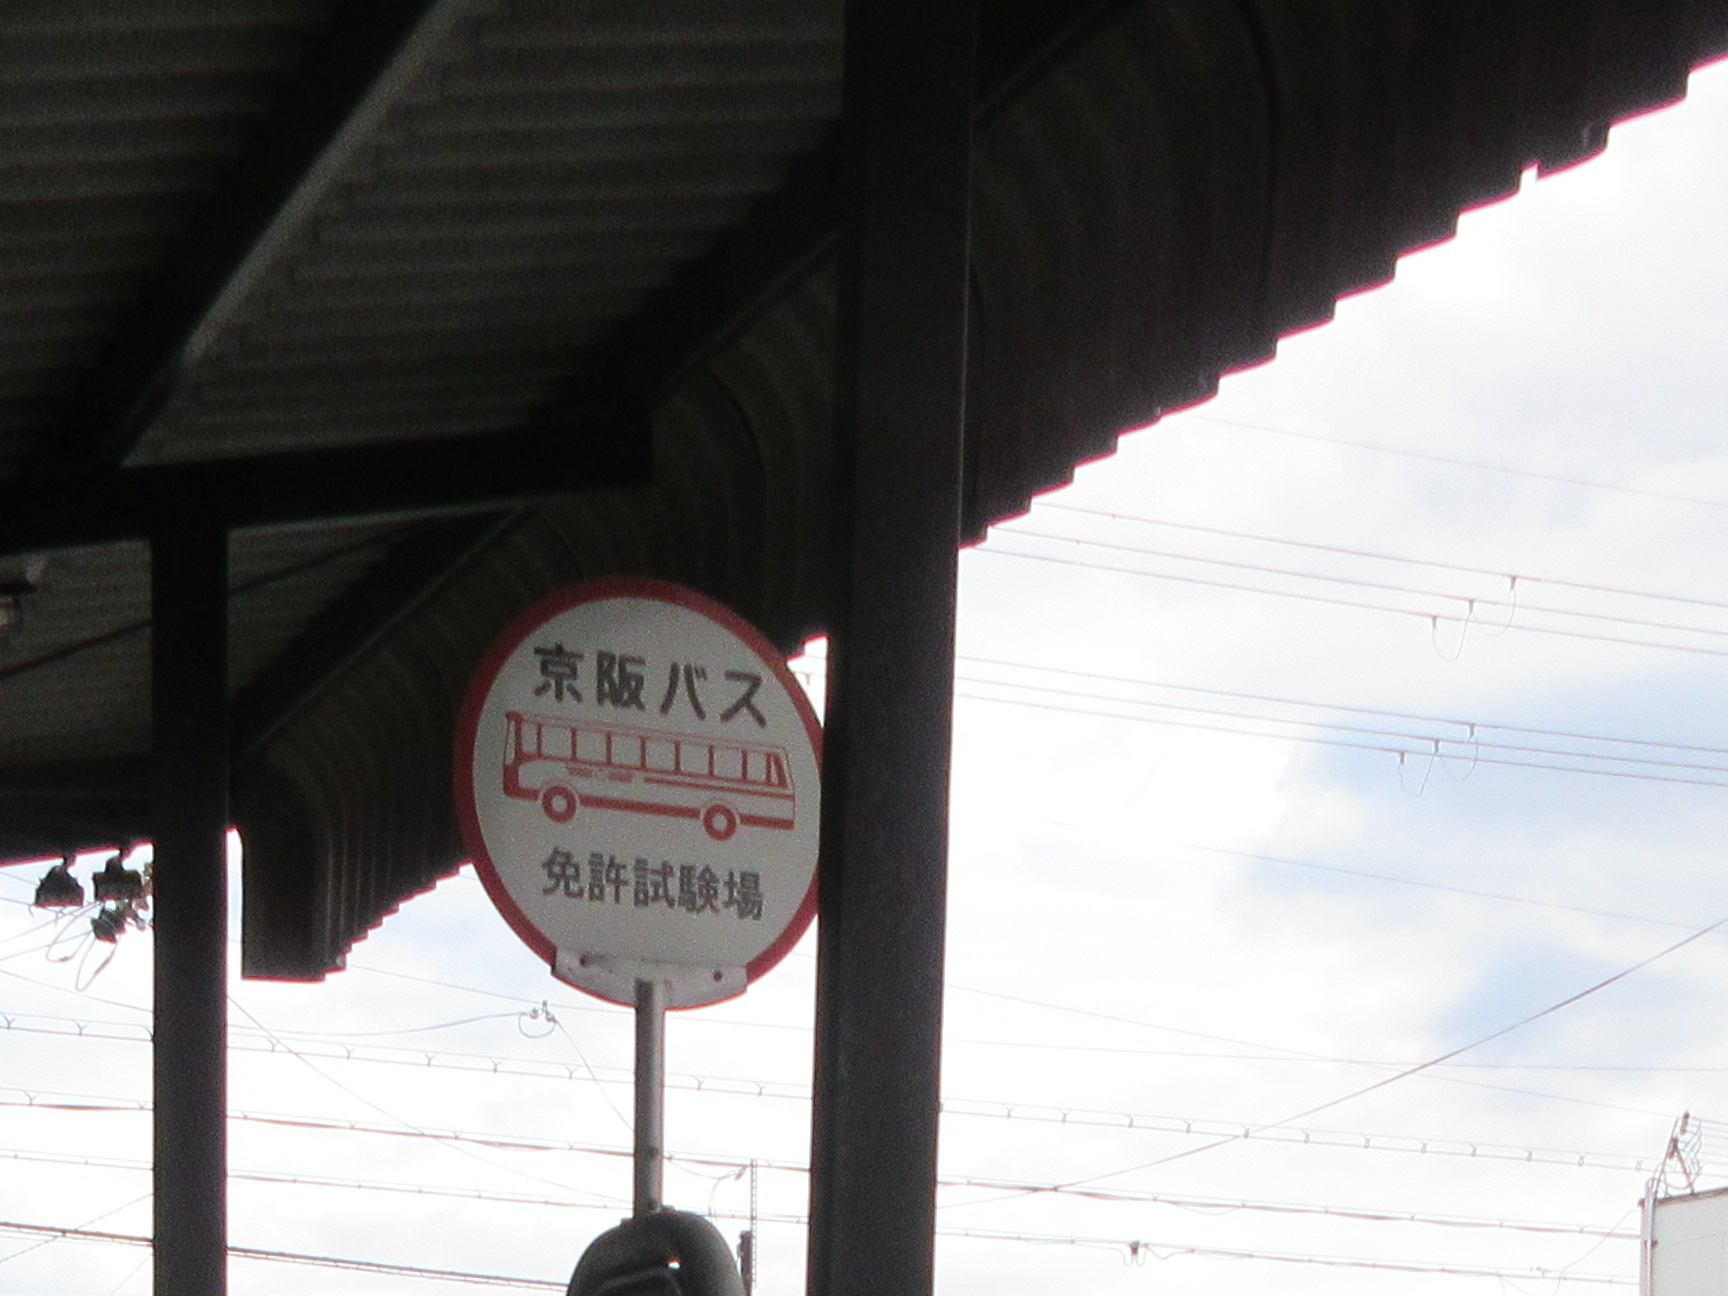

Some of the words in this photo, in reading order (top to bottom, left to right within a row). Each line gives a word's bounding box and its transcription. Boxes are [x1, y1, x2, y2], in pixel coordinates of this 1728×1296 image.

[534, 643, 767, 728] 京阪バス
[542, 847, 763, 920] 免許試験場
